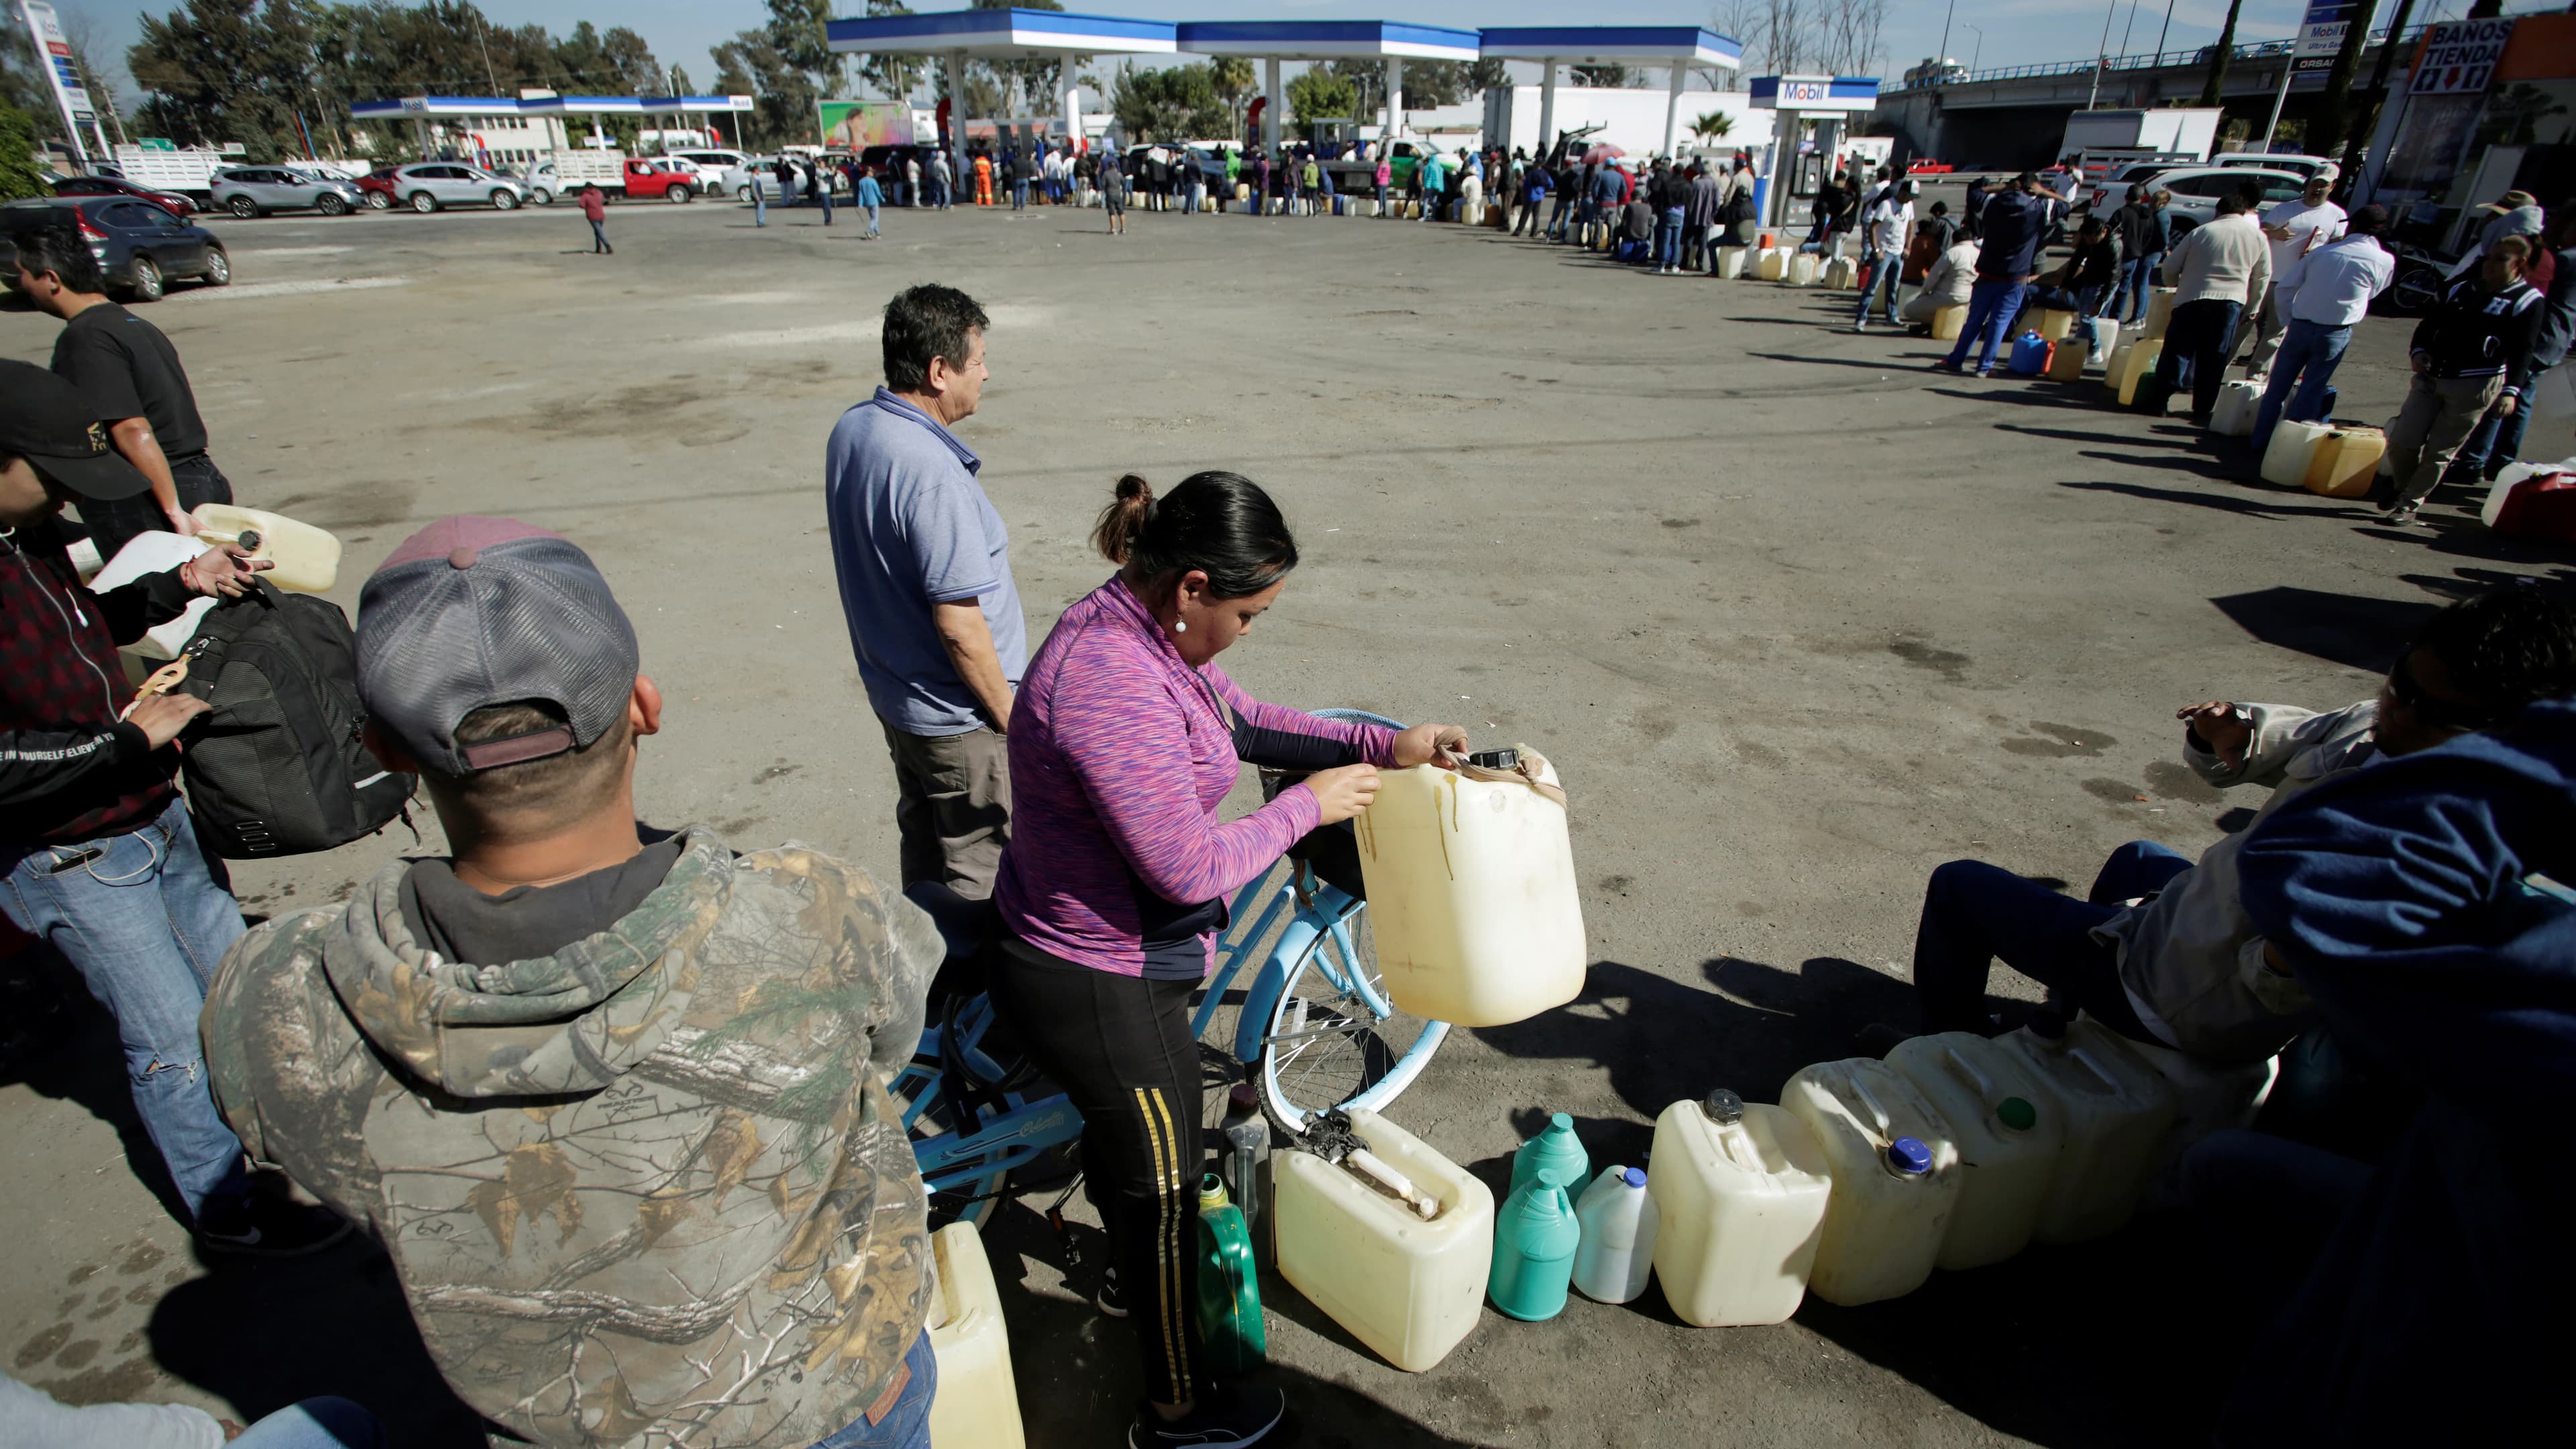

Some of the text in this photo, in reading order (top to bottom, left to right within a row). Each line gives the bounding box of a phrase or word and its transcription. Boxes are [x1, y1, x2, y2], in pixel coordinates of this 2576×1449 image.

[2311, 25, 2340, 37] Mobil
[2425, 44, 2500, 66] TIENDA
[1784, 83, 1824, 99] Mobil
[5, 750, 16, 760] IN
[19, 750, 65, 761] YOURSELF
